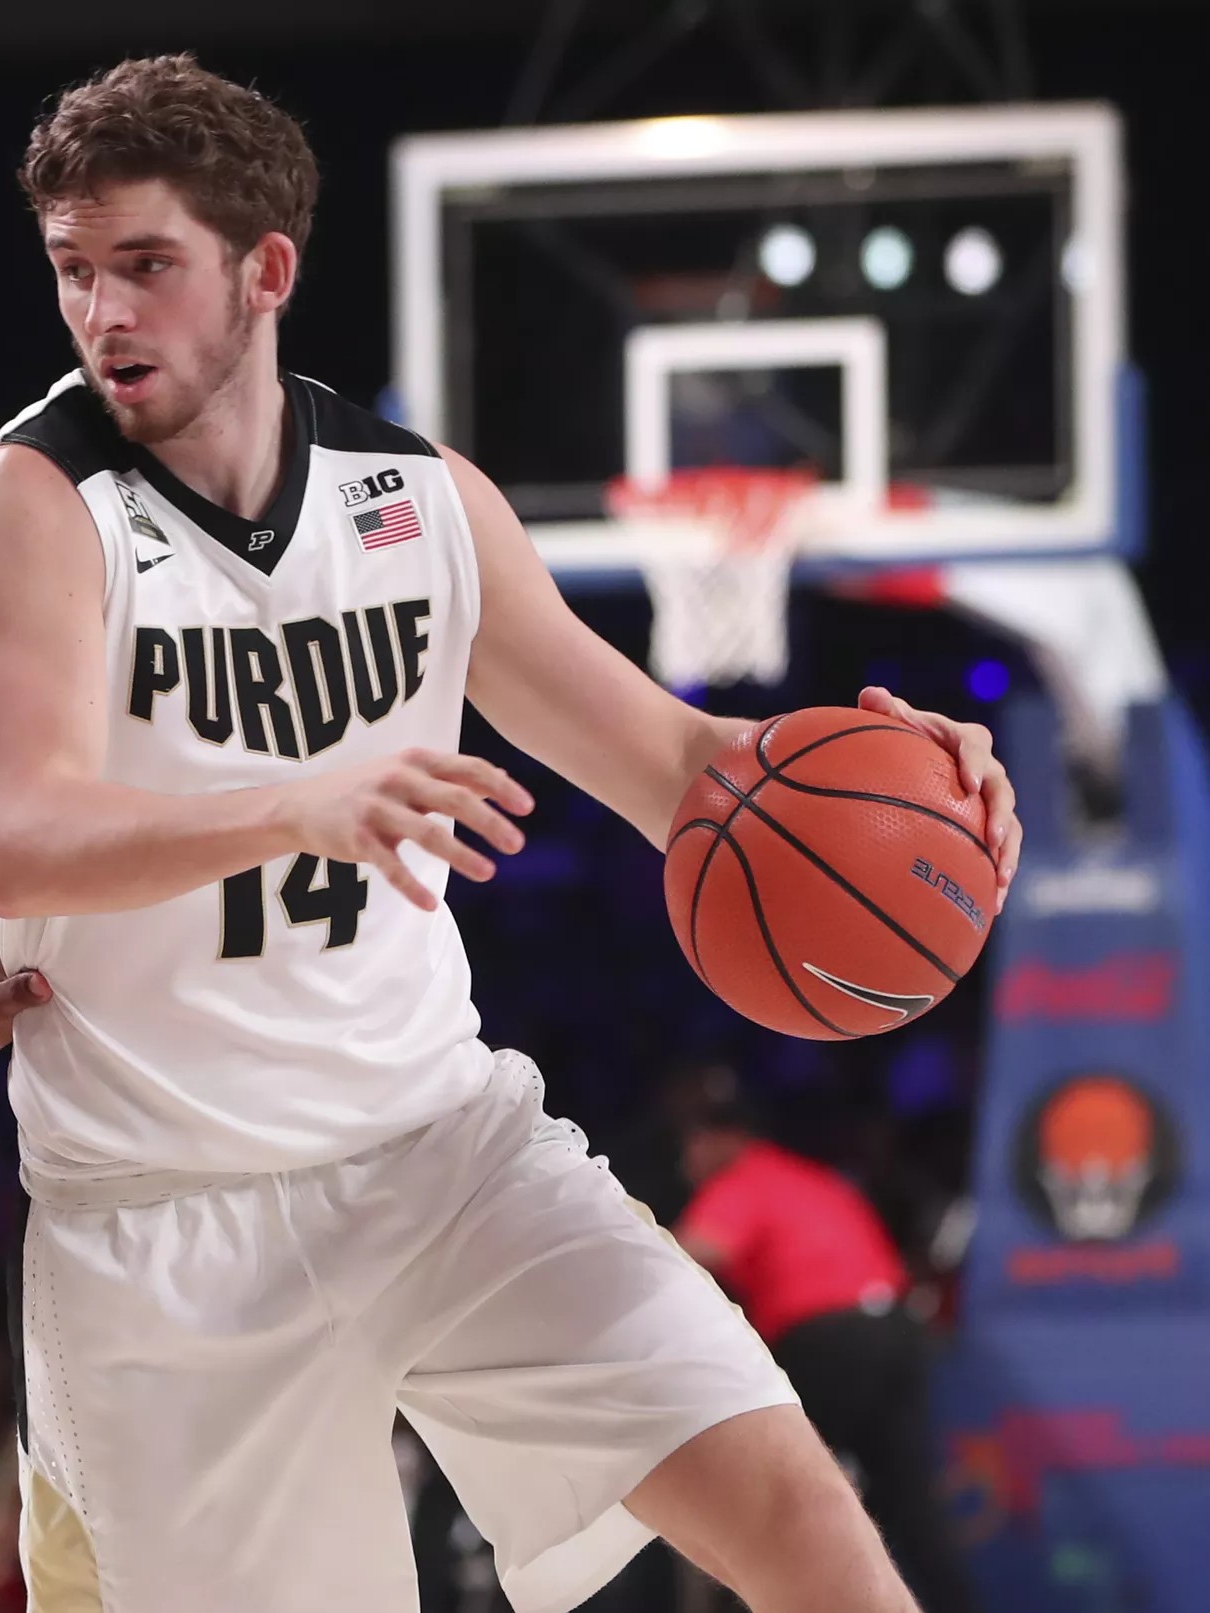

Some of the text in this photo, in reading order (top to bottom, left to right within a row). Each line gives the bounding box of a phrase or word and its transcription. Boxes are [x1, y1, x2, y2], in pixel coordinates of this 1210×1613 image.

[248, 530, 274, 551] P
[127, 597, 431, 763] PURDUE
[215, 852, 370, 961] 14
